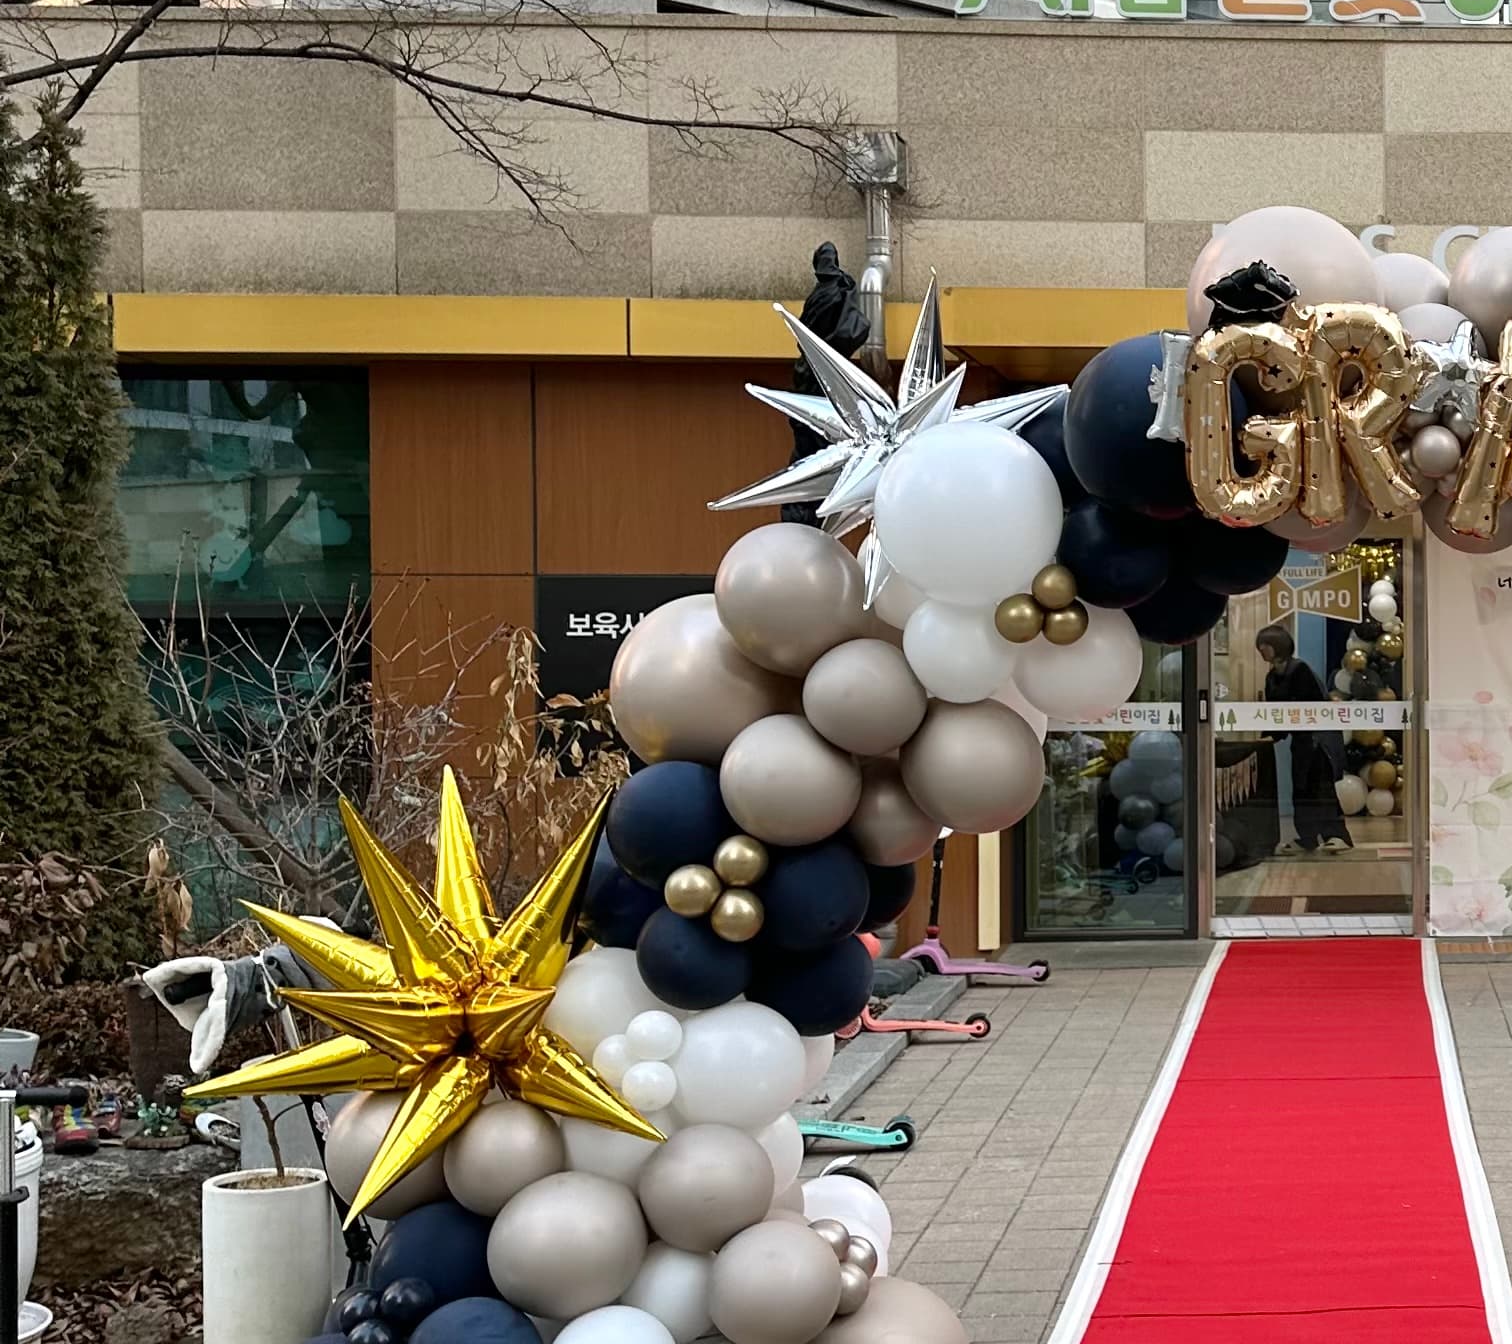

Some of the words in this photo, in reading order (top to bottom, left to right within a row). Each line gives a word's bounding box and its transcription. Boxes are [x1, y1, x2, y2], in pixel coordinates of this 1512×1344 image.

[1282, 567, 1304, 577] FULL
[1305, 567, 1324, 577] LIFE
[1276, 589, 1352, 609] GIMPO
